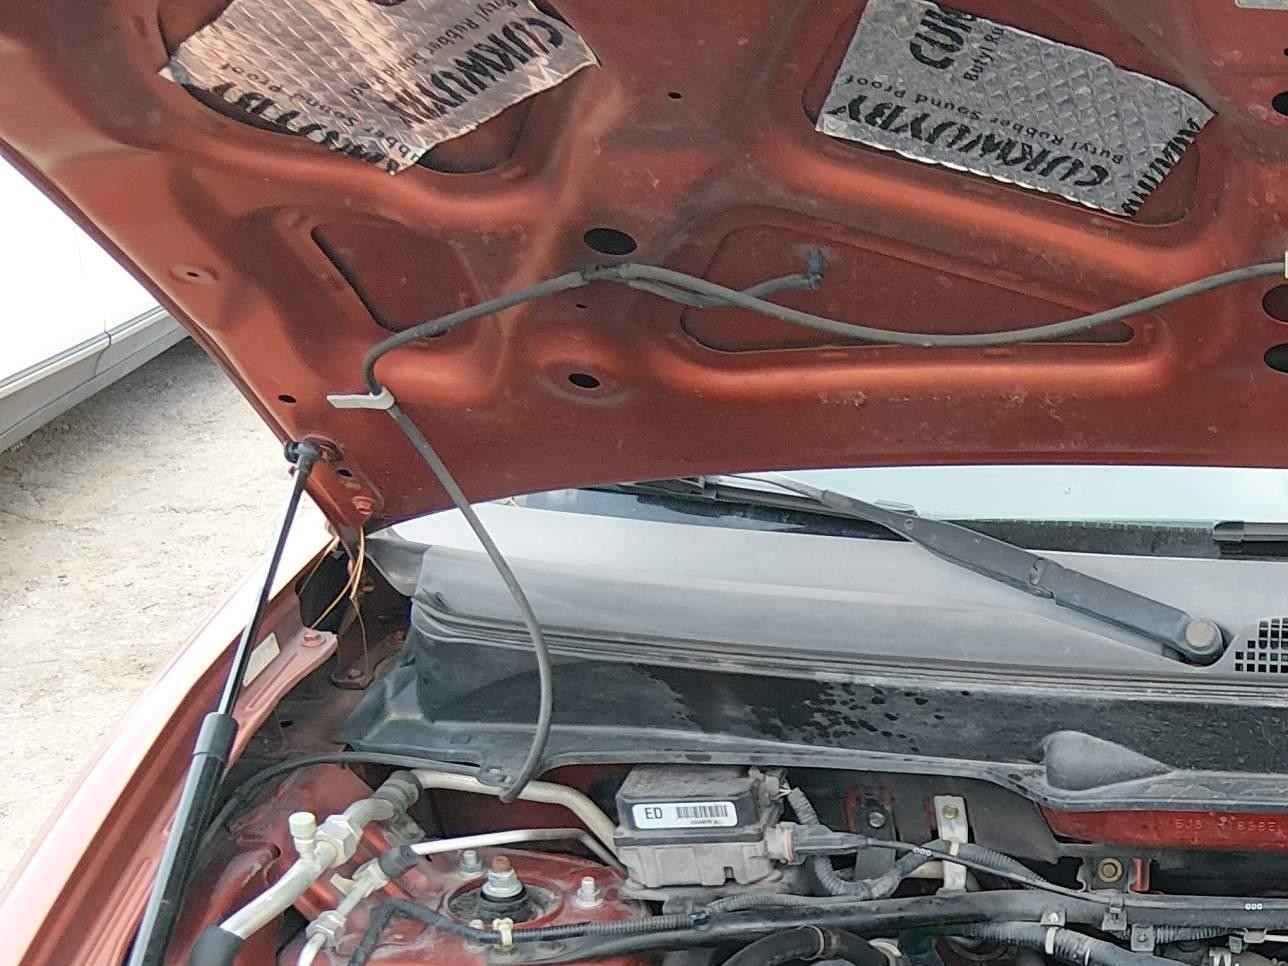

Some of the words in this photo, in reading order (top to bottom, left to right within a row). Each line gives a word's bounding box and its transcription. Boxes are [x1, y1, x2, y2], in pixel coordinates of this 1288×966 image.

[843, 74, 907, 98] Proof
[915, 93, 984, 121] Sound
[990, 115, 1064, 147] Rubber
[1070, 140, 1124, 165] Butyl
[644, 807, 663, 819] ED
